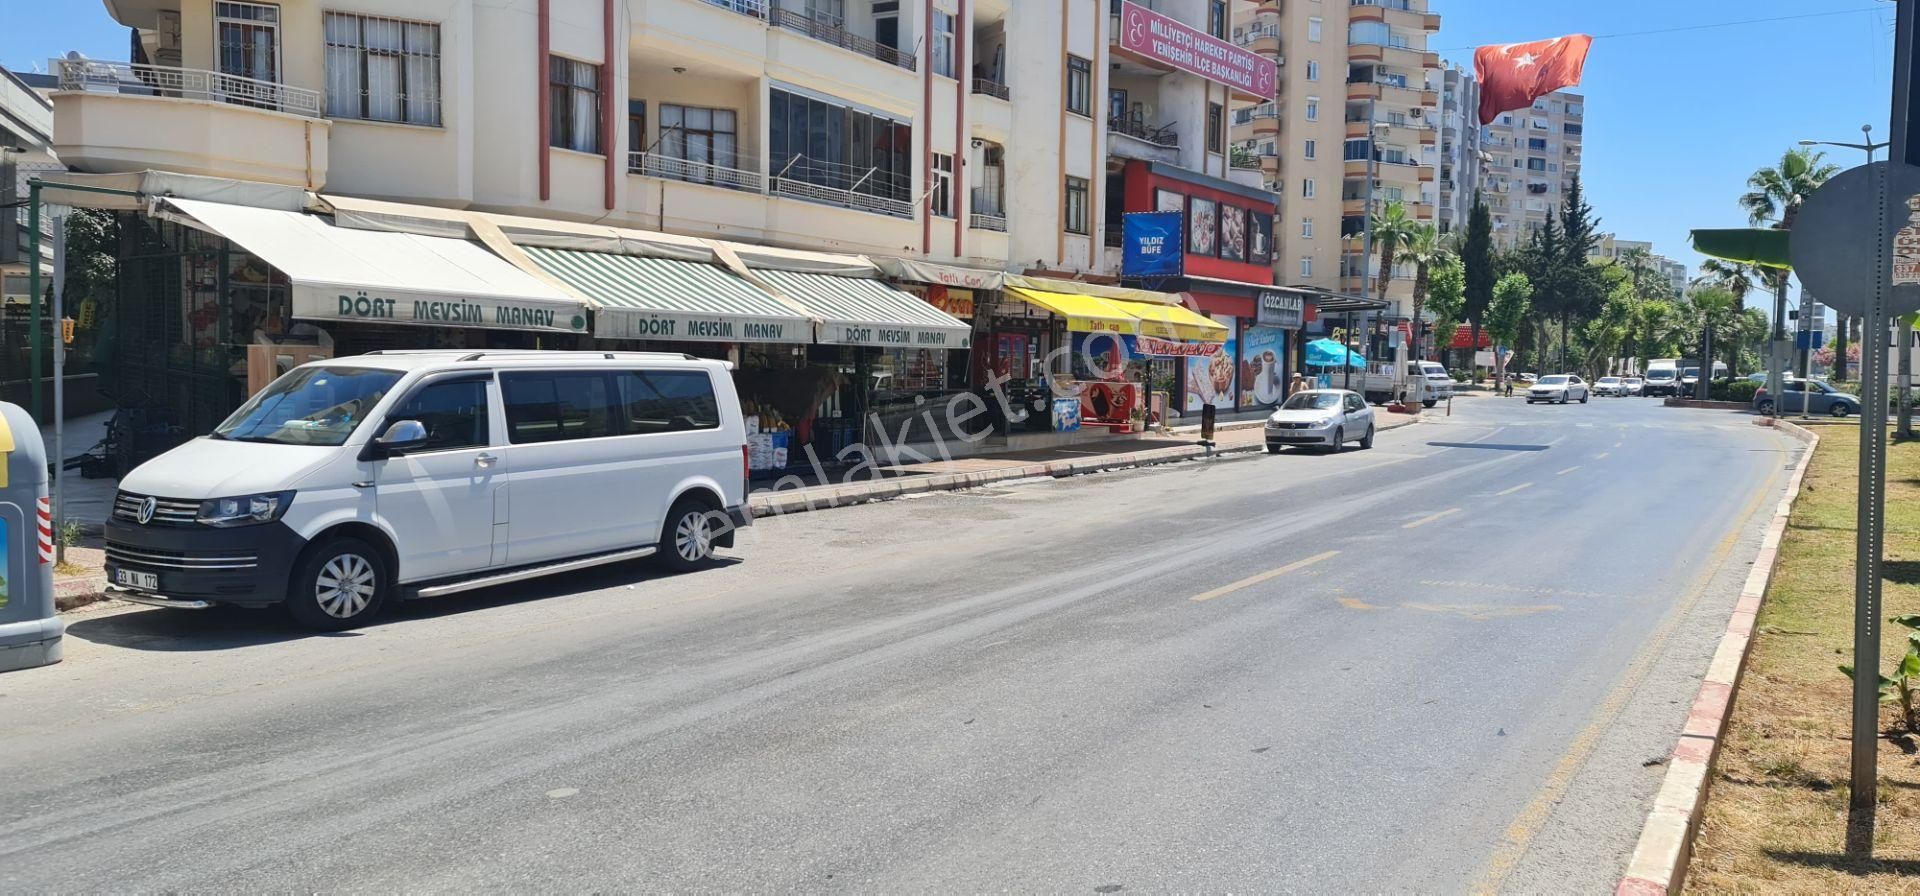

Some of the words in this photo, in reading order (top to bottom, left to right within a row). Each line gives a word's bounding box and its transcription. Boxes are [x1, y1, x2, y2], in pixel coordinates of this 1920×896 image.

[1150, 18, 1193, 49] MİLLİYETÇİ
[1195, 38, 1228, 61] HAREKET
[1229, 49, 1255, 72] PARTİSİ
[1152, 39, 1193, 66] YENİŞEHİR
[1194, 52, 1211, 75] İLÇE
[1212, 63, 1252, 88] BAŞKANLIĞI
[1139, 236, 1164, 245] YILDIZ
[1141, 245, 1161, 254] BÜFE
[338, 291, 396, 318] DÖRT
[413, 298, 483, 323] MEVSİM
[496, 305, 555, 327] MANAV
[1264, 292, 1302, 311] ÖZCANLAR
[639, 314, 676, 335] DÖRT
[688, 318, 733, 337] MEVSİM
[744, 323, 783, 339] MANAV
[846, 325, 871, 342] DÖRT
[878, 327, 911, 343] MEVSİM
[917, 331, 947, 344] MANAV
